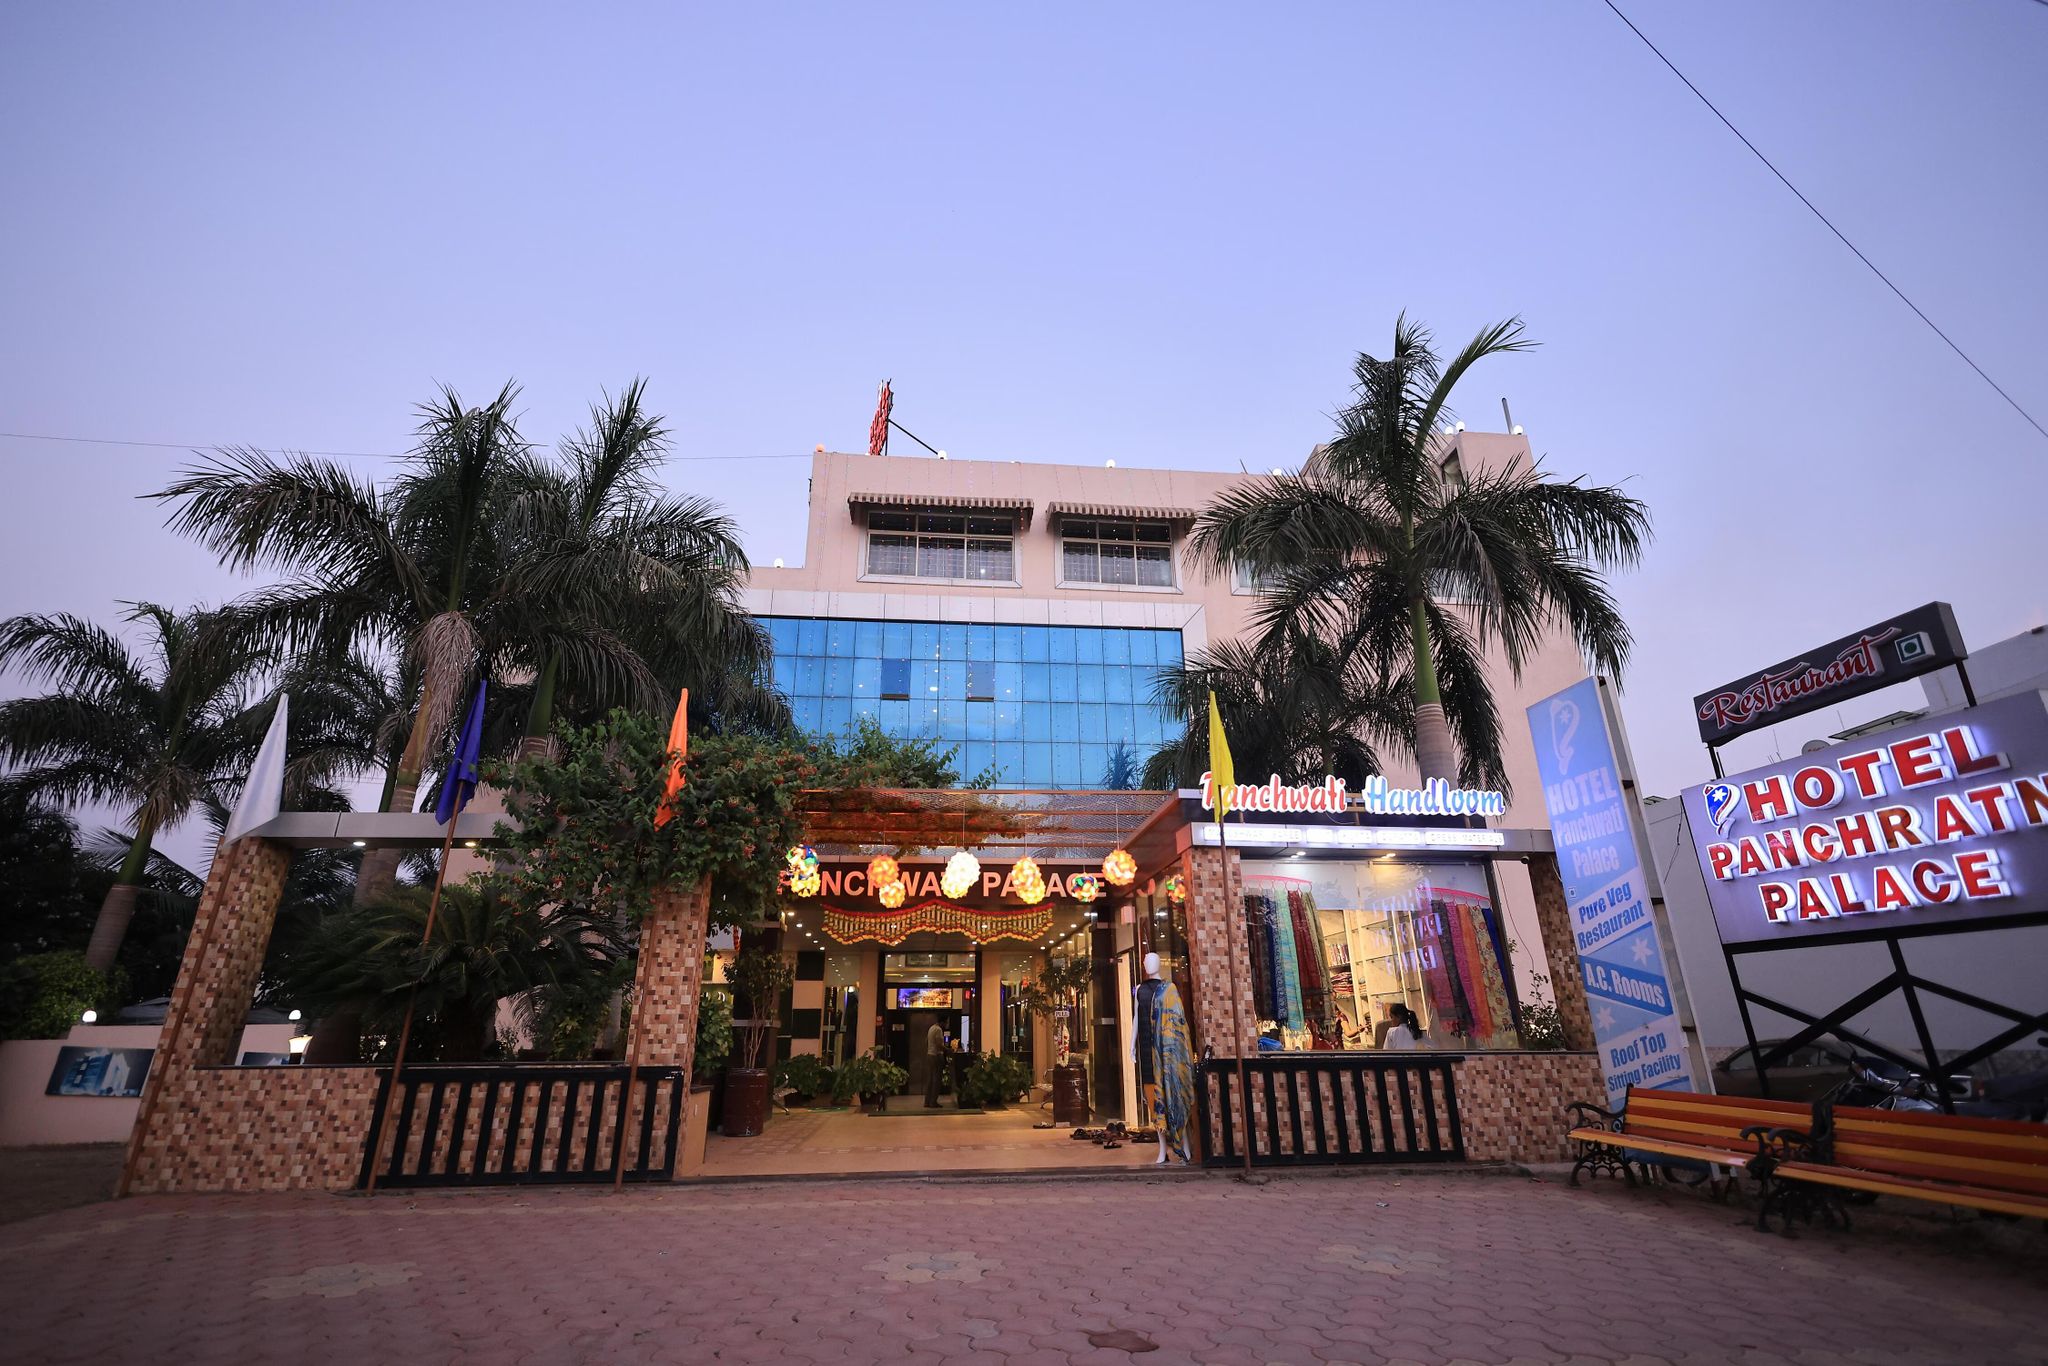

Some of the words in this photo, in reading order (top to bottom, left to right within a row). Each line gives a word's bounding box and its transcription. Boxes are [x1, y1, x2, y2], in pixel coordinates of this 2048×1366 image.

[1698, 627, 1901, 729] Restaurant
[1363, 774, 1505, 816] Handloom
[1547, 767, 1617, 815] HOTEL
[1743, 725, 2010, 825] HOTEL
[1554, 802, 1624, 847] Panchwati
[1572, 846, 1620, 878] Palace
[1579, 897, 1606, 924] Pure
[1606, 881, 1632, 907] Veg
[1758, 848, 2012, 923] PALACE
[1577, 900, 1645, 950] Restaurant
[1585, 963, 1612, 992] A.C.
[1611, 970, 1665, 1007] Rooms
[1610, 1040, 1640, 1068] Roof
[1640, 1032, 1667, 1056] Top
[1608, 1070, 1640, 1091] Sitting
[1642, 1054, 1681, 1080] Facility
